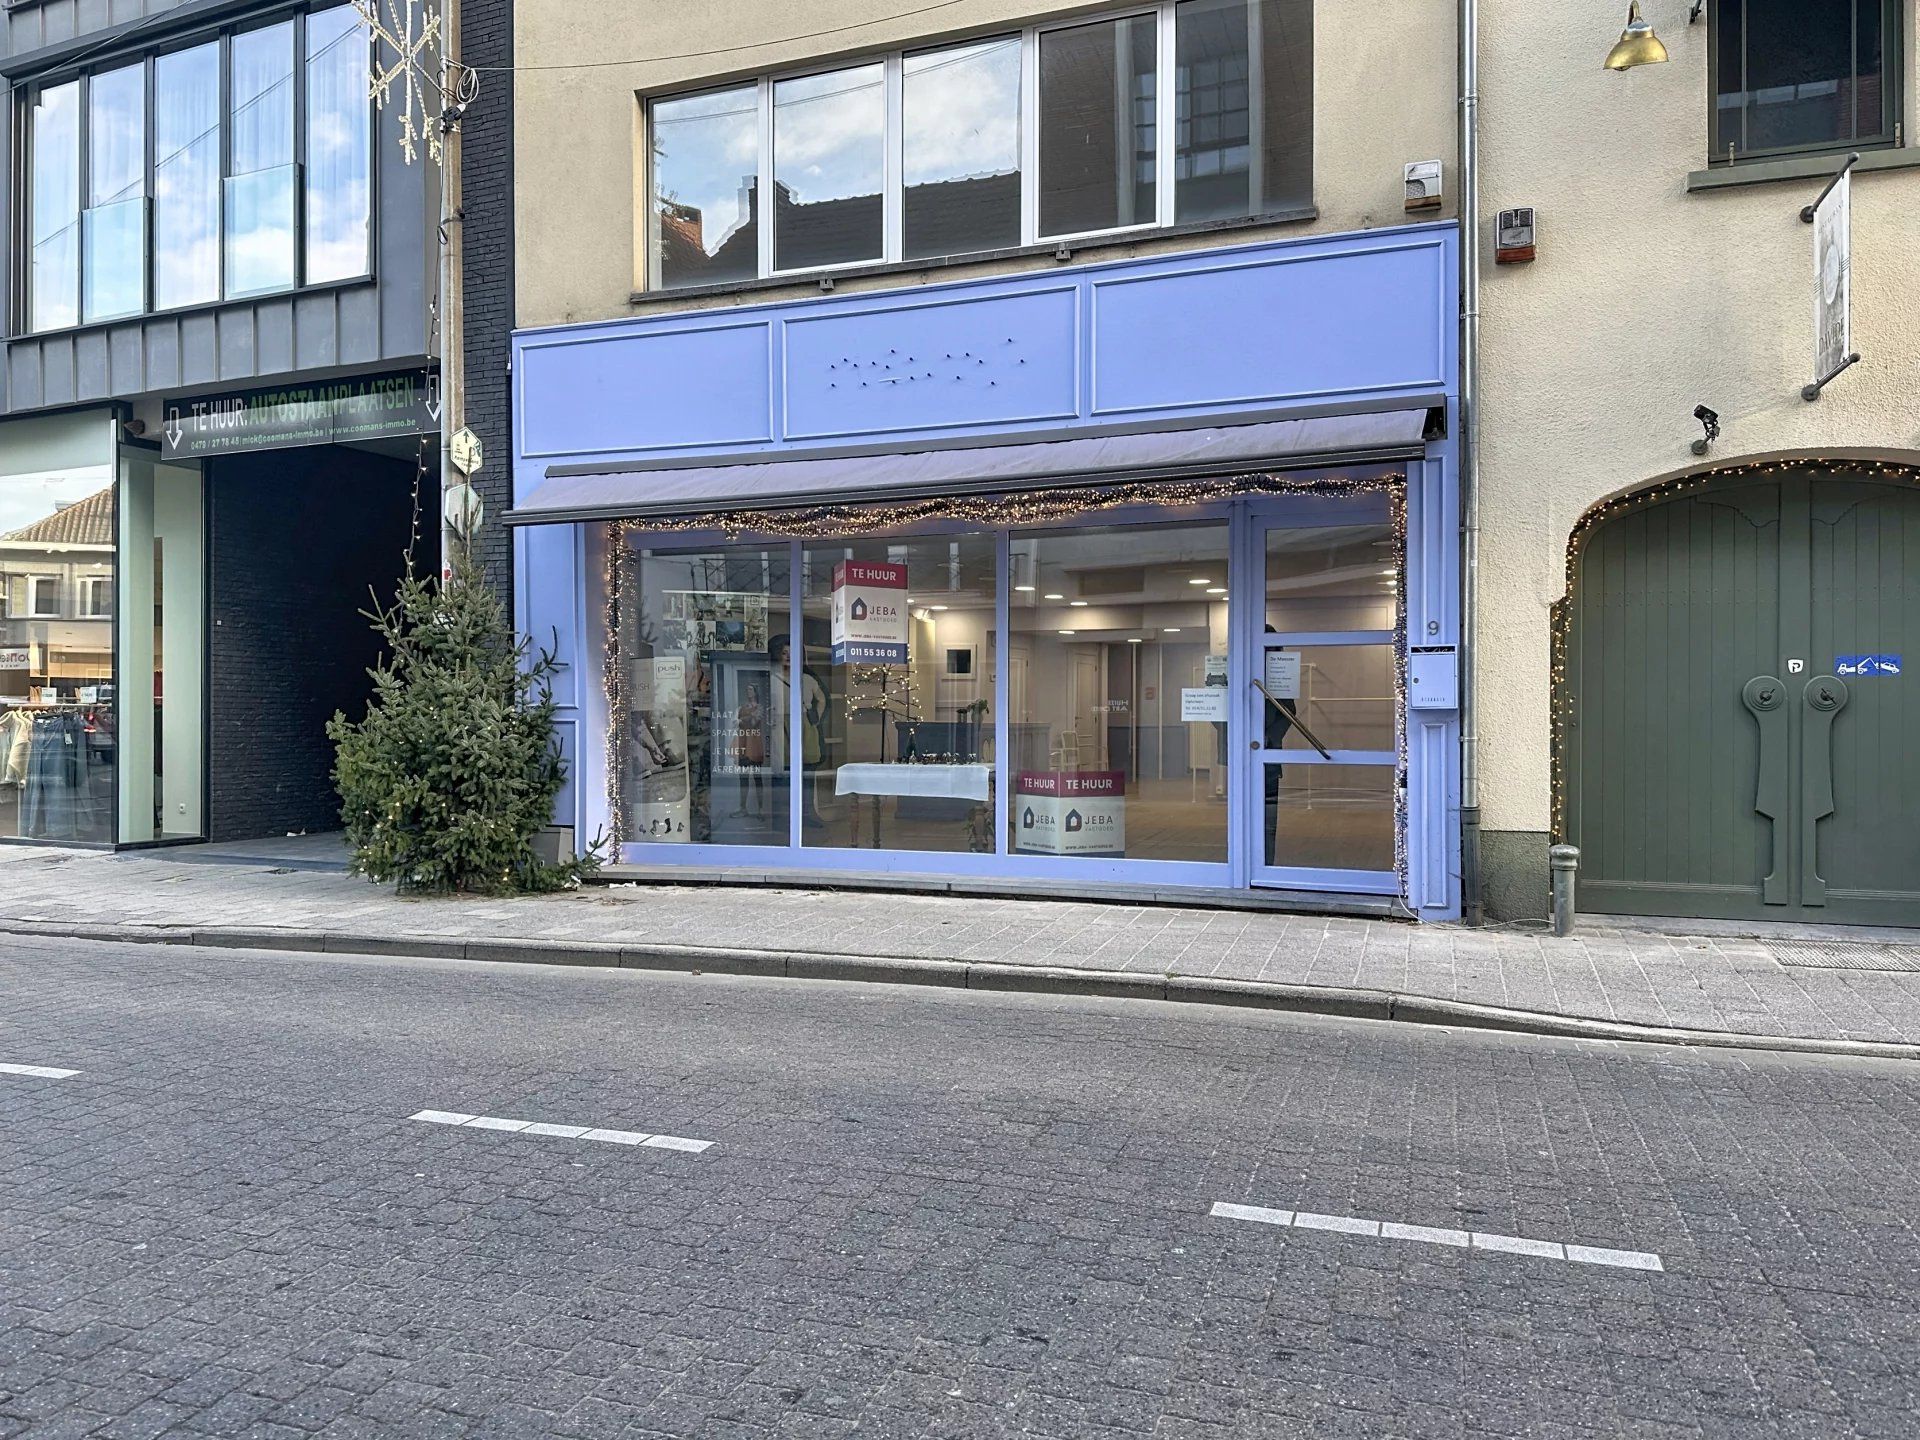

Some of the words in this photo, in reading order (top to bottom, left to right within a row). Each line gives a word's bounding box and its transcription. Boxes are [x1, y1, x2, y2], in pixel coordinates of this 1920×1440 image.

[192, 402, 207, 432] TE
[210, 398, 248, 430] HUUR:
[249, 376, 414, 425] AUTOSTAANPLAATSEN
[852, 568, 864, 579] TE
[866, 569, 897, 581] HUUR
[869, 606, 897, 616] JEBA
[1428, 620, 1439, 636] 9
[850, 647, 862, 656] 011
[864, 648, 874, 656] 55
[875, 649, 885, 657] 36
[886, 650, 897, 658] 08
[657, 663, 681, 674] push
[711, 711, 733, 719] LAAT
[711, 728, 761, 737] SPATADERS
[724, 747, 746, 755] NIET
[1024, 777, 1033, 788] TE
[1033, 778, 1055, 790] HUUR
[1066, 779, 1079, 790] TE
[1081, 779, 1113, 789] HUUR
[1035, 814, 1056, 825] JEBA
[1084, 815, 1114, 825] JEBA
